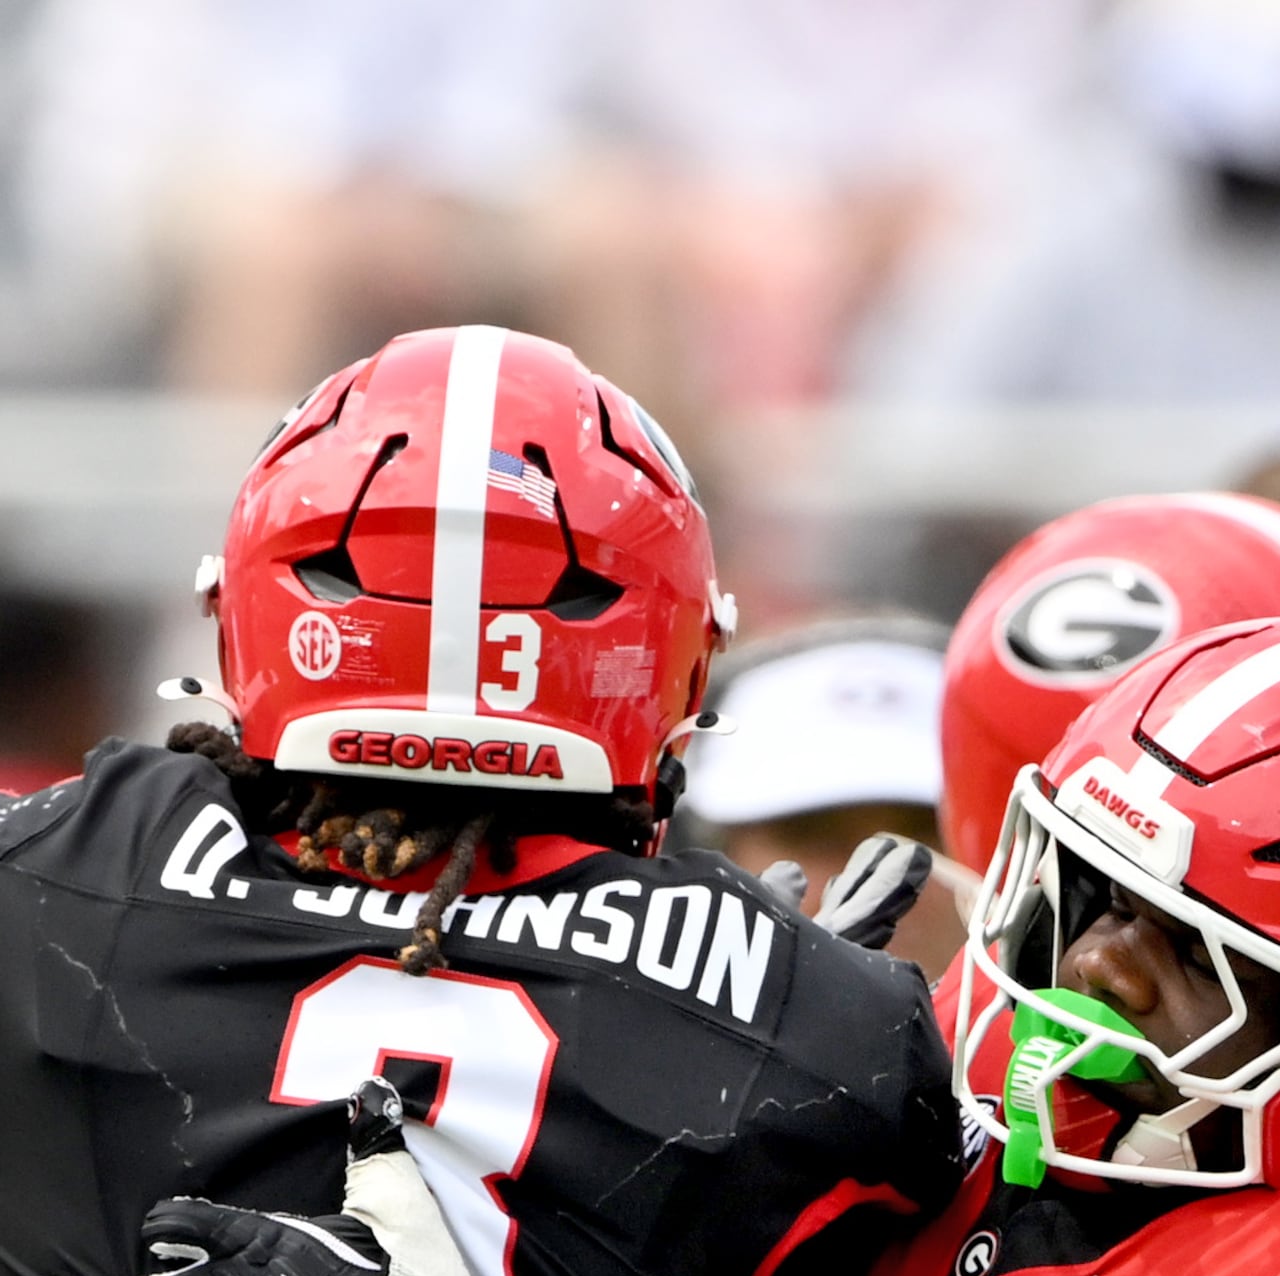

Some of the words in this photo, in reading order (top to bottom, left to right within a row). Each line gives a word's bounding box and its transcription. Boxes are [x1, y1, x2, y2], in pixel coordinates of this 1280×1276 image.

[294, 616, 337, 674] SEC
[480, 613, 542, 711] 3
[328, 729, 564, 780] GEORGIA
[1083, 776, 1161, 840] DAWGS
[160, 803, 251, 899] Q.
